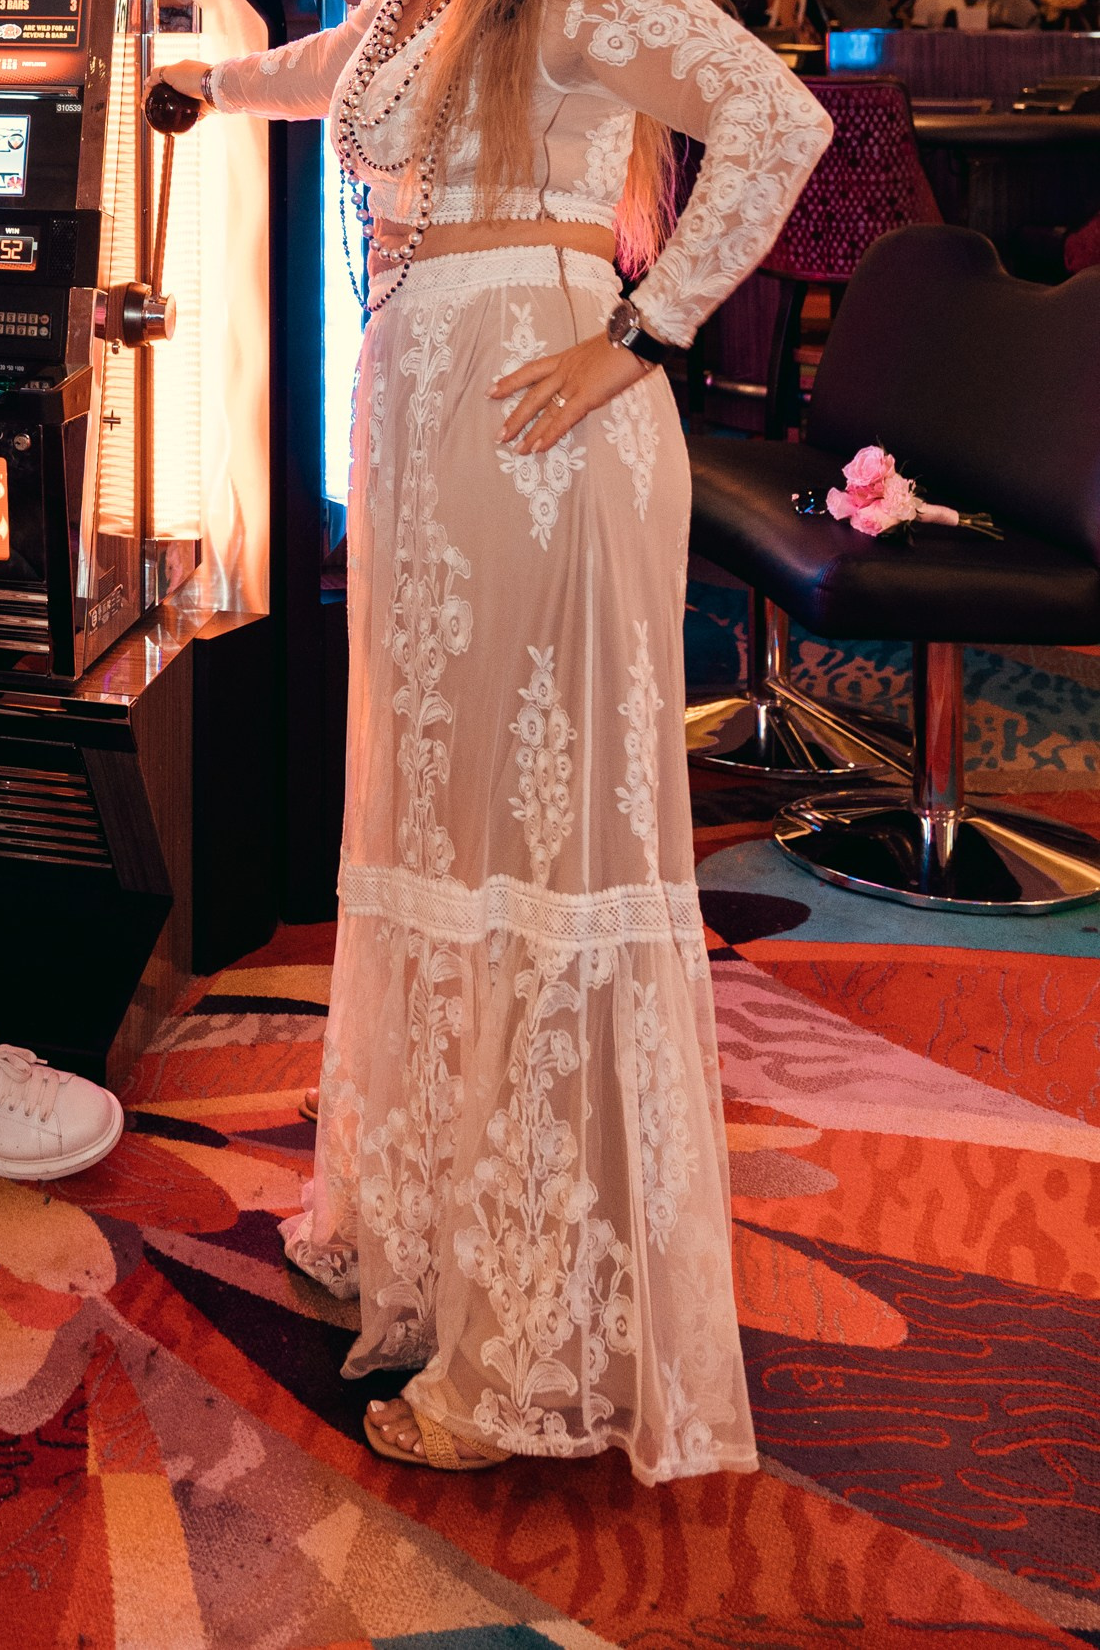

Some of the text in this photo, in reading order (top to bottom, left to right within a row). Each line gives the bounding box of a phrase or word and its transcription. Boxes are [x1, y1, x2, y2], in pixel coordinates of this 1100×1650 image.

[0, 0, 6, 10] 3
[6, 0, 30, 10] BARS
[70, 0, 78, 12] 3
[0, 240, 23, 260] 52
